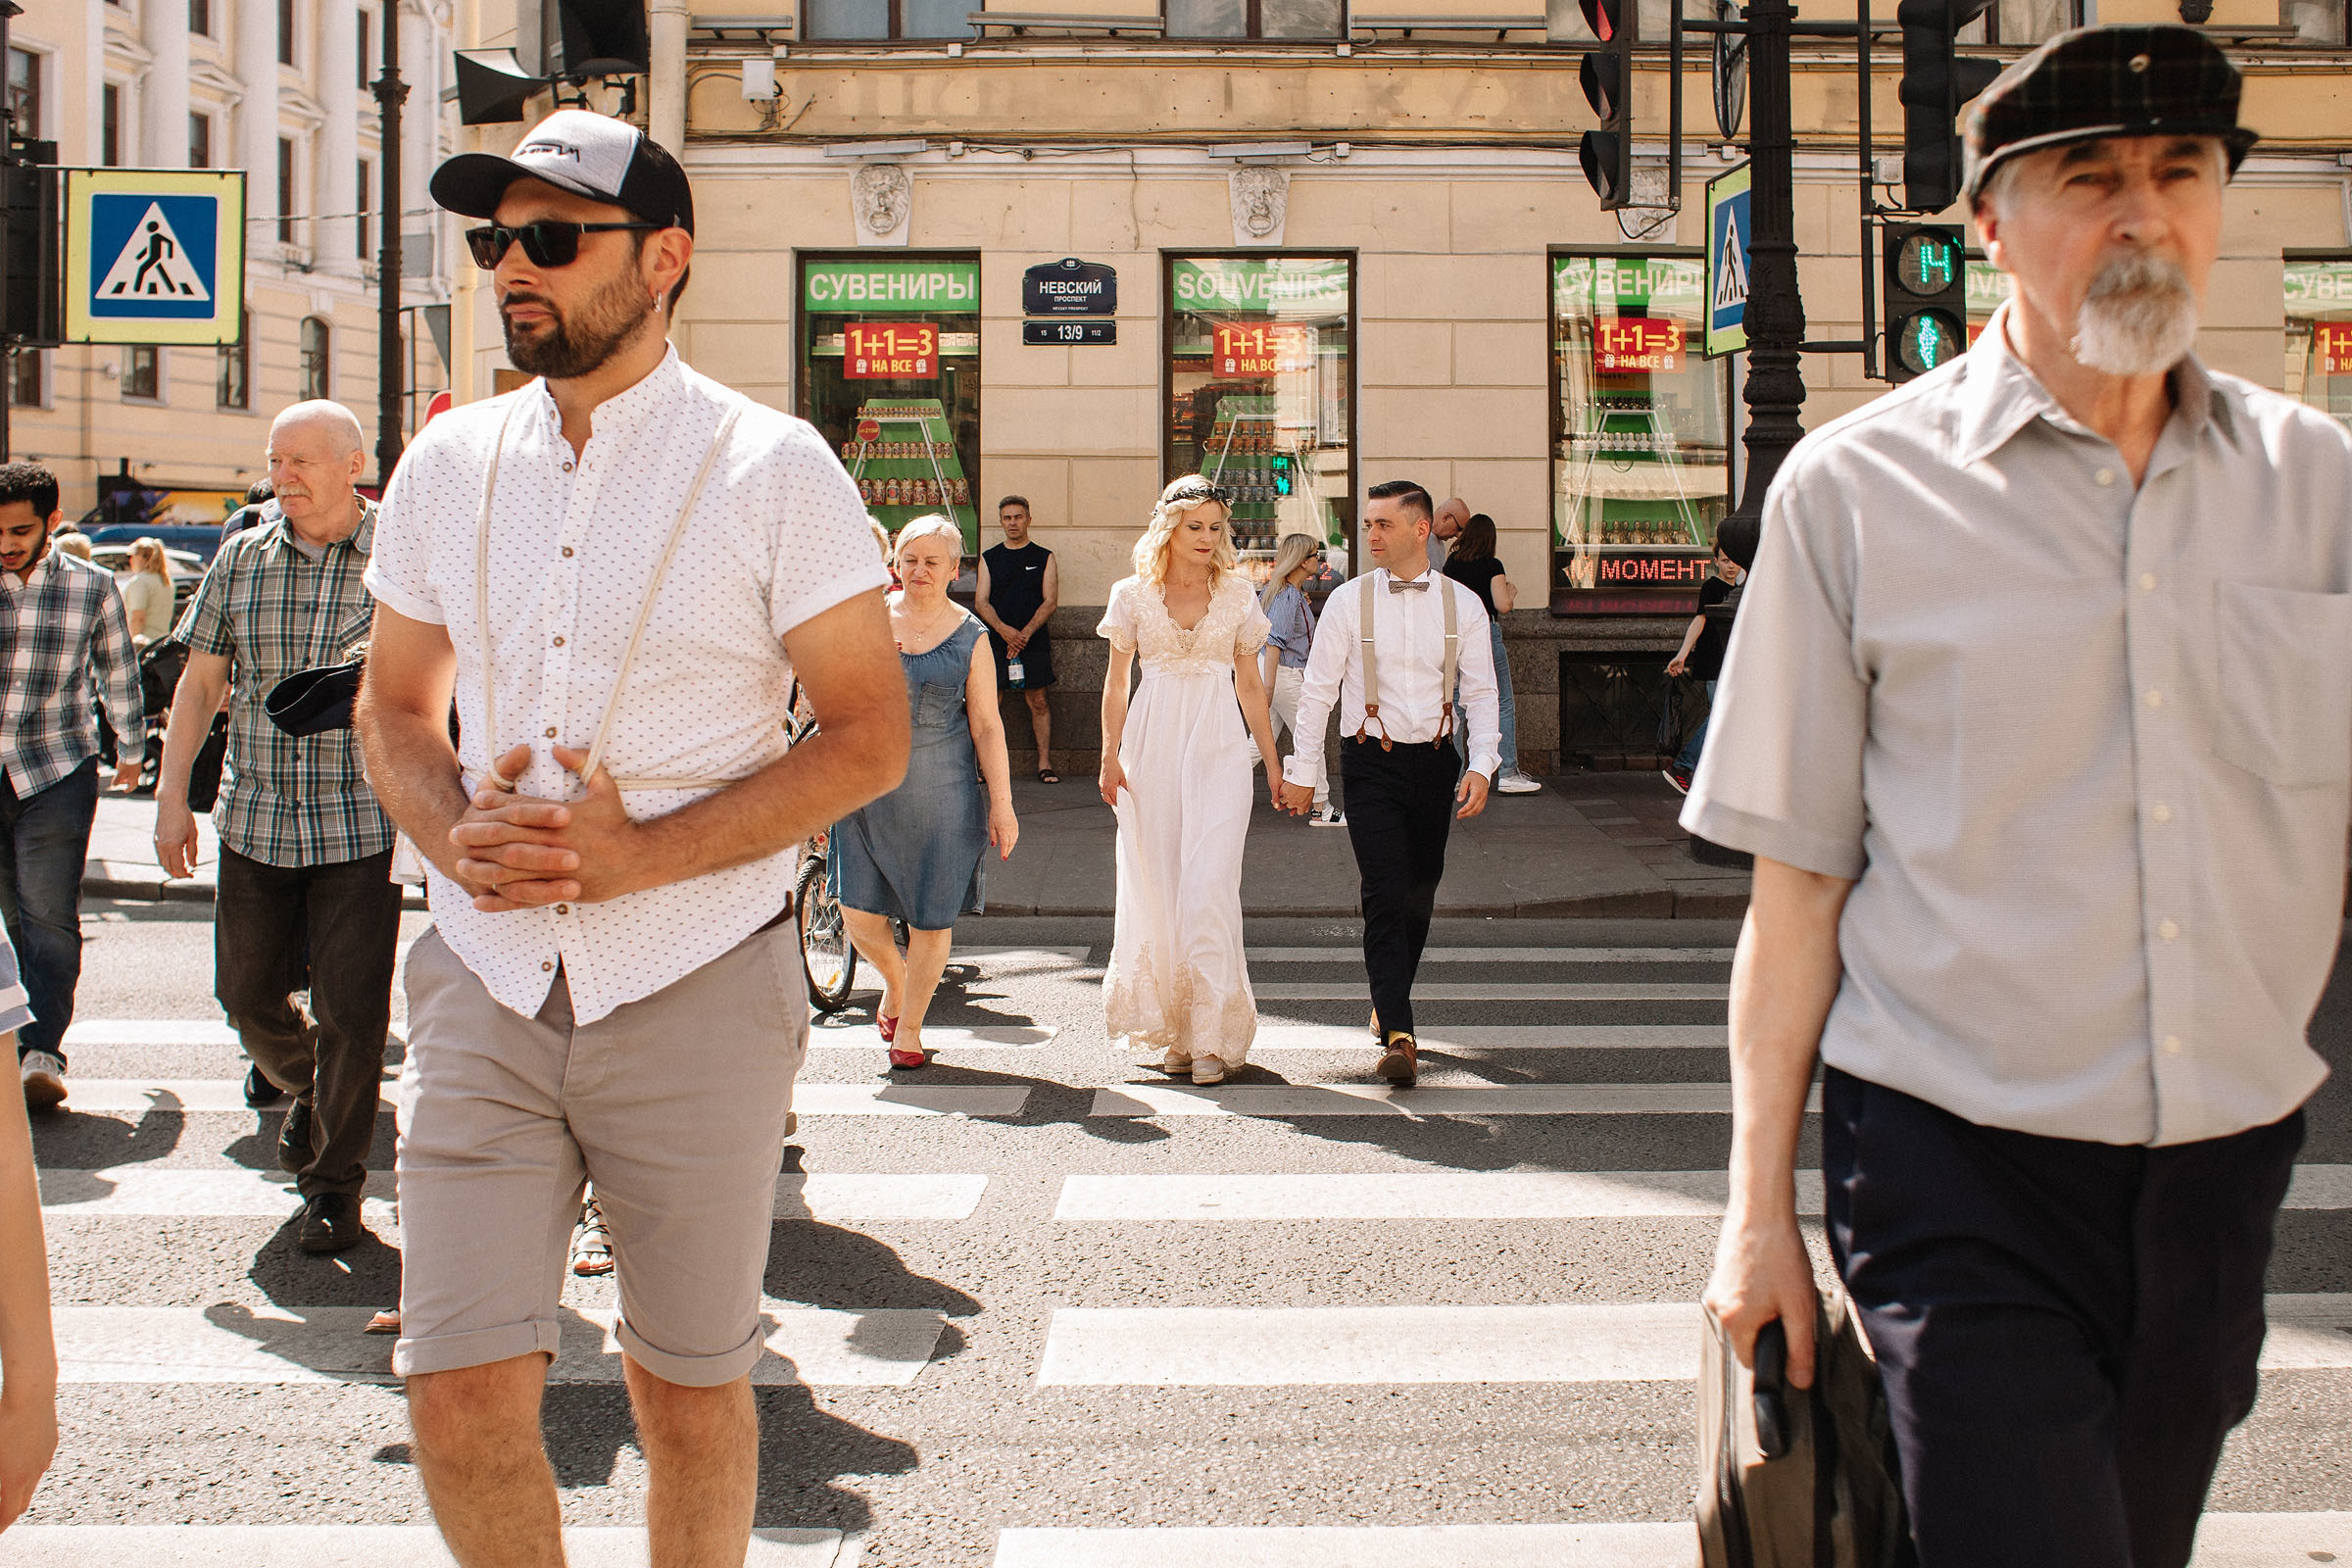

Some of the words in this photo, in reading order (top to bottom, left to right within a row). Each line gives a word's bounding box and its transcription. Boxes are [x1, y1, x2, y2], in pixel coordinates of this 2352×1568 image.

[1921, 245, 1951, 282] 14
[809, 273, 974, 300] СУВЕНИРЫ
[1039, 279, 1102, 294] НЕВСКИЙ
[1177, 272, 1343, 300] SOUVENIRS
[851, 329, 933, 357] 1+1=3
[1058, 324, 1083, 340] 13/9
[1219, 328, 1302, 356] 1+1=3
[1599, 324, 1681, 352] 1+1=3
[871, 360, 888, 372] НА
[891, 360, 912, 372] ВСЕ
[1241, 359, 1257, 371] НА
[1620, 355, 1636, 368] НА
[1639, 355, 1660, 368] ВСЕ
[1601, 560, 1711, 580] МОМЕНТ
